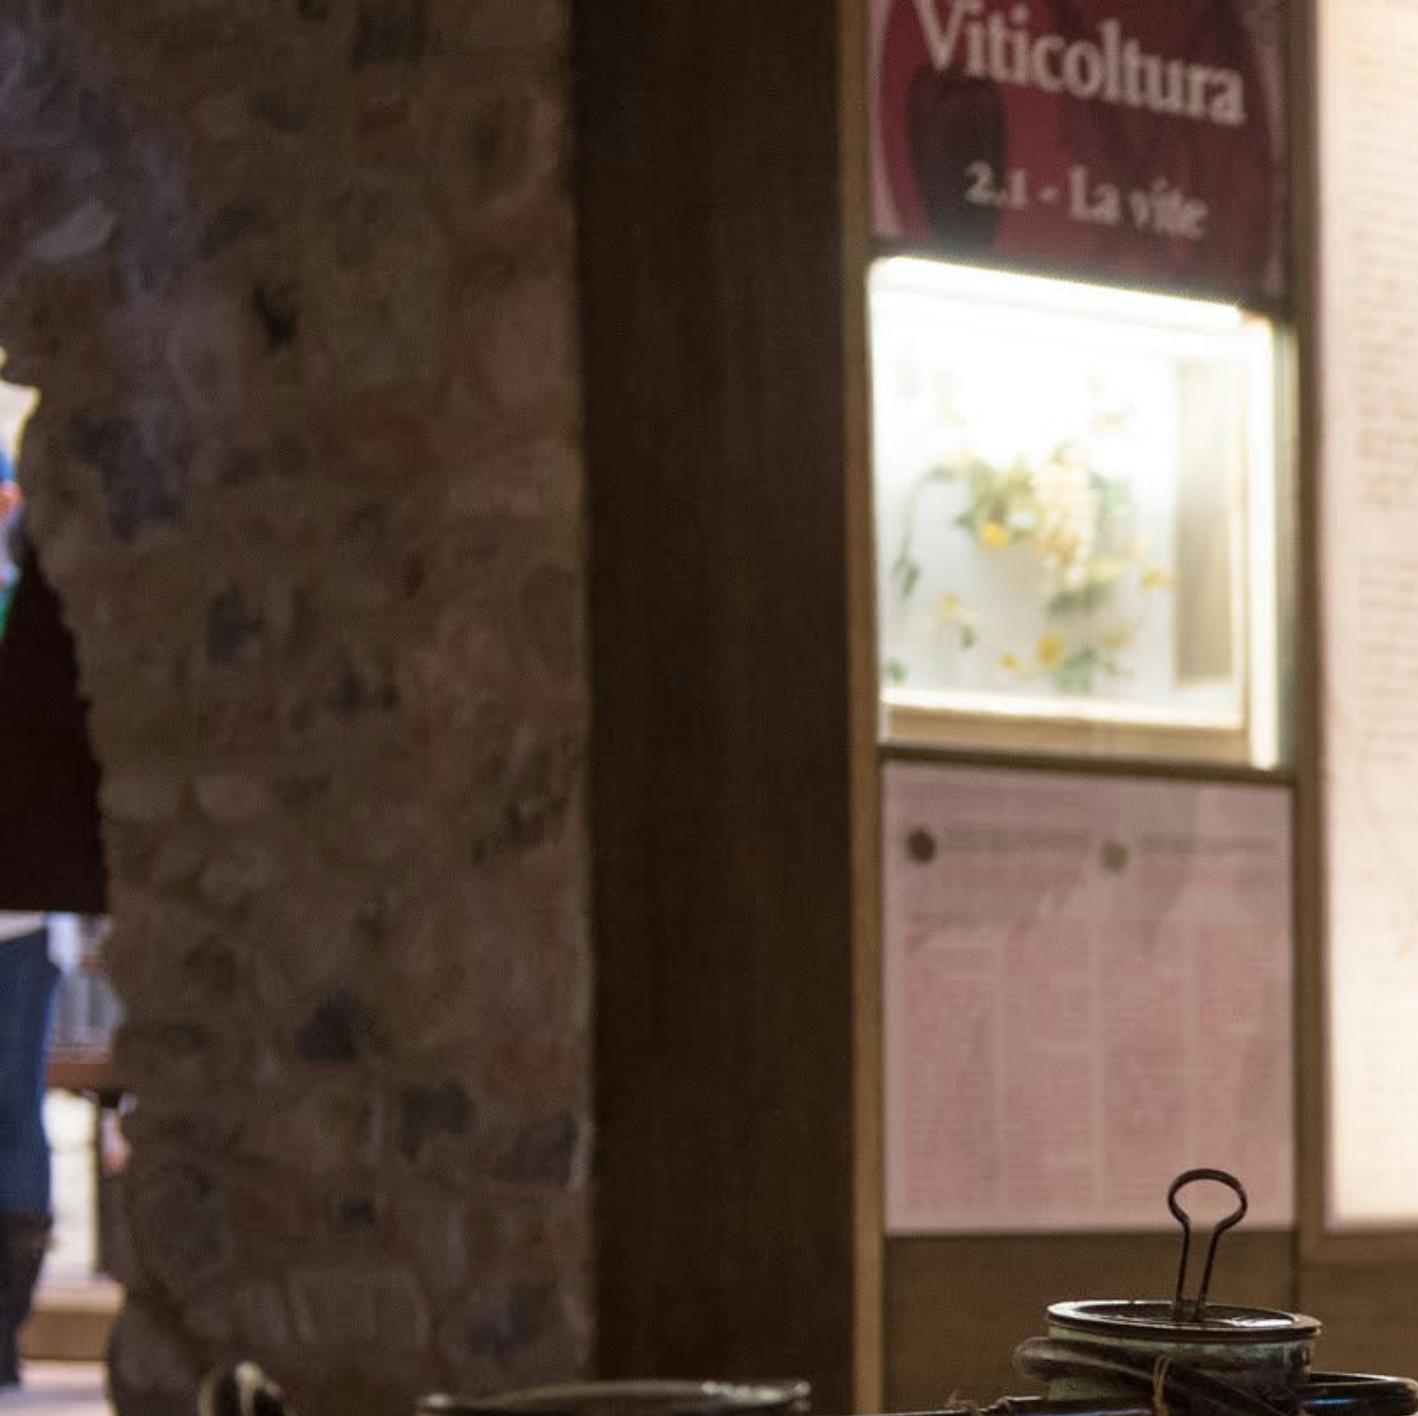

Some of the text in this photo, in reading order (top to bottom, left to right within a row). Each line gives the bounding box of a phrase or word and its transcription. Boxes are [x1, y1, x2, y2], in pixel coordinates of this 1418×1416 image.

[917, 0, 1246, 126] Viticoltura
[963, 158, 1026, 212] 2.1
[1067, 163, 1124, 227] La
[1130, 175, 1209, 241] vite
